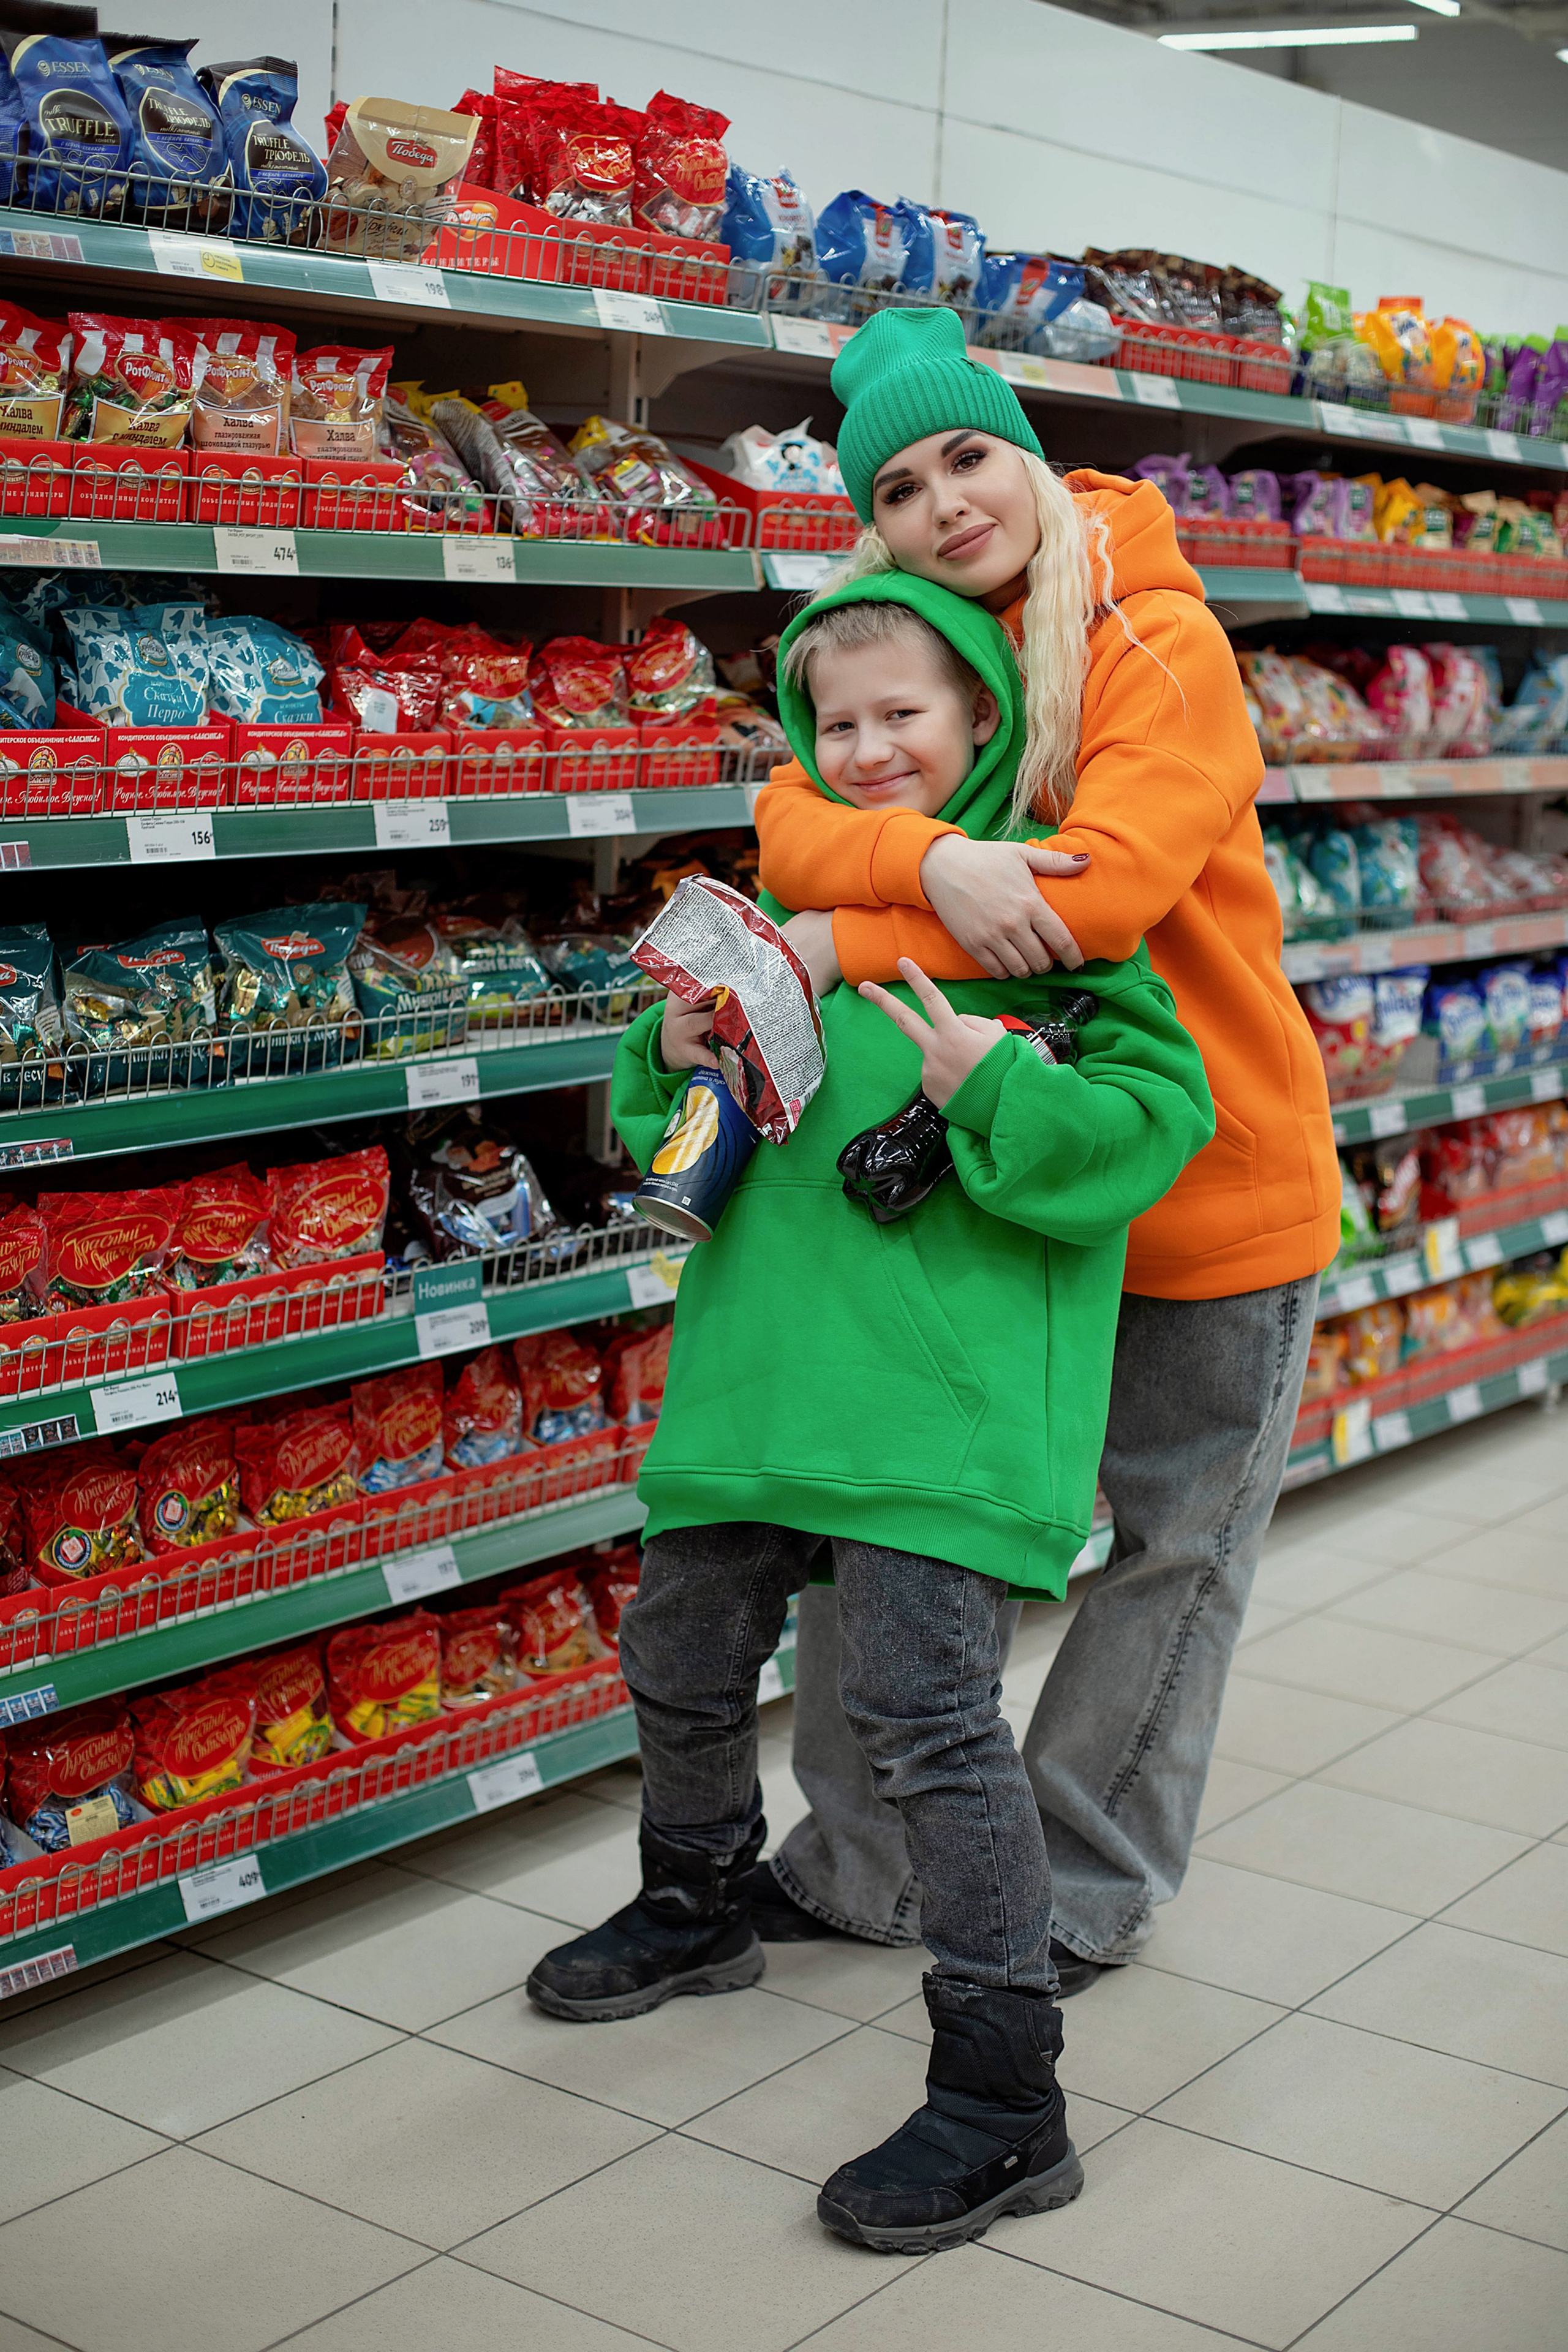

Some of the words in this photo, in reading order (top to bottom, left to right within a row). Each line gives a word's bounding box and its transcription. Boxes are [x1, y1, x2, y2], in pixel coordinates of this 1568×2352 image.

[53, 61, 91, 73] ESSEN
[148, 98, 188, 116] TRUFFLE
[253, 96, 282, 114] ESSEN
[45, 118, 114, 137] TRUFFLE
[164, 113, 211, 129] ТРЮФЕЛЬ
[252, 135, 290, 149] TRUFFLE
[265, 149, 311, 163] ТРЮФЕЛЬ
[391, 140, 434, 165] Победа
[425, 282, 443, 296] 198
[0, 404, 33, 420] Халва
[129, 418, 160, 432] Халва
[223, 417, 254, 428] Халва
[120, 432, 167, 446] миндалем
[326, 430, 355, 442] Халва
[273, 547, 294, 561] 474
[497, 556, 512, 569] 136
[144, 687, 183, 704] Сказки
[148, 704, 185, 723] Перро
[275, 710, 313, 723] Сказки
[62, 788, 101, 805] Вкусное!
[187, 783, 225, 800] Вкусное!
[429, 819, 446, 832] 259
[192, 831, 211, 845] 156
[66, 1223, 140, 1270] Красный
[418, 1277, 477, 1300] Новинка
[156, 1390, 176, 1406] 214
[57, 1732, 118, 1781] Красный
[238, 1872, 258, 1888] 409
